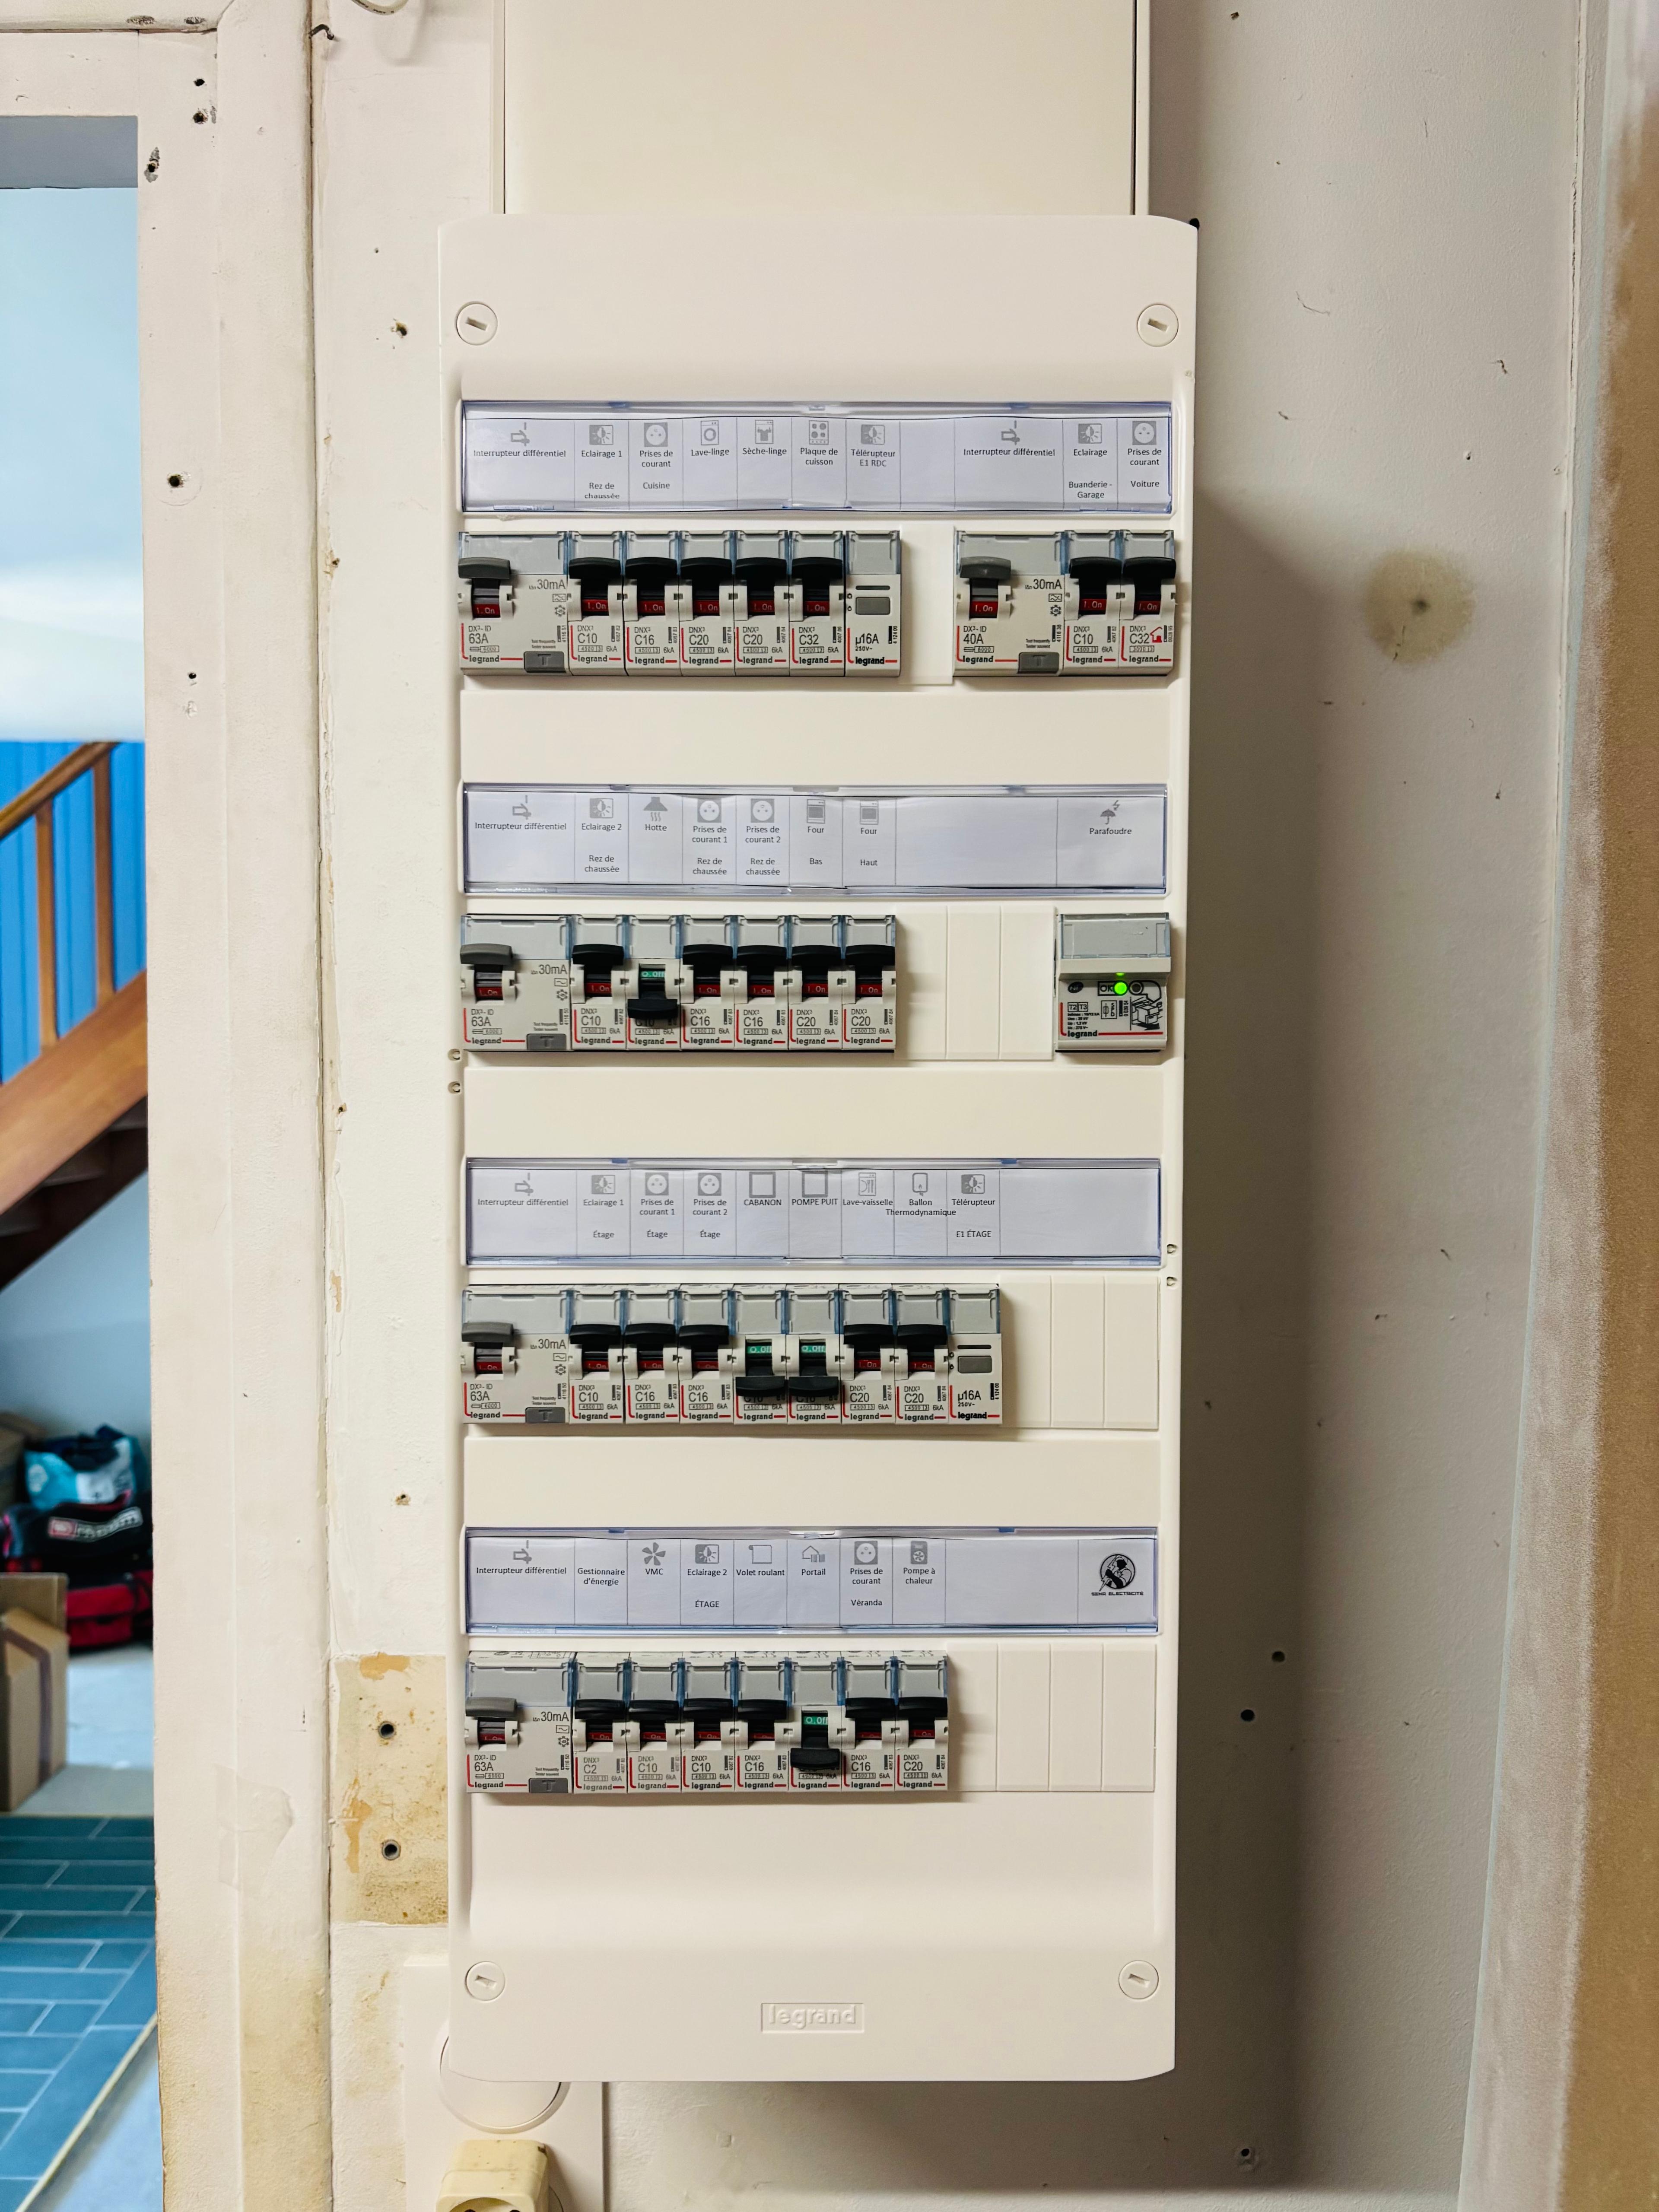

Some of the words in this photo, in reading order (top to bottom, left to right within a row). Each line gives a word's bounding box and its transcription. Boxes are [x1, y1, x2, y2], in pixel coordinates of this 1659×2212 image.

[581, 450, 616, 459] Eclairage
[691, 448, 730, 457] Lave-linge
[743, 447, 787, 456] Sèche-linge
[800, 447, 826, 456] Plaque
[850, 449, 896, 458] Télérupteur
[1013, 448, 1055, 456] différentiel
[1074, 449, 1108, 457] Eclairage
[469, 634, 489, 644] 63A
[577, 633, 597, 644] C10
[635, 634, 655, 645] C16
[689, 634, 709, 645] C20
[743, 634, 763, 645] C20
[799, 634, 819, 645] C32
[963, 633, 984, 645] 40A
[1073, 633, 1093, 645] C10
[1129, 633, 1150, 644] C32
[469, 655, 499, 664] legrand
[578, 655, 607, 664] legrand
[855, 656, 885, 666] legrand
[1073, 655, 1103, 665] legrand
[475, 822, 522, 831] Interrupteur
[582, 823, 616, 832] Eclairage
[471, 1016, 491, 1027] 63A
[581, 1016, 601, 1026] C10
[690, 1016, 710, 1027] C16
[744, 1017, 763, 1027] C16
[796, 1017, 816, 1027] C20
[851, 1016, 871, 1027] C20
[1067, 1030, 1098, 1039] legrand
[744, 1037, 773, 1046] legrand
[796, 1037, 826, 1046] legrand
[477, 1198, 524, 1207] Interrupteur
[583, 1199, 617, 1208] Eclairage
[951, 1198, 996, 1207] Télérupteur
[593, 1230, 615, 1239] Étage
[647, 1229, 668, 1239] Étage
[700, 1229, 721, 1239] Étage
[967, 1229, 992, 1238] ÉTAGE
[470, 1391, 490, 1401] 63A
[578, 1392, 598, 1402] C10
[635, 1391, 655, 1402] C16
[688, 1392, 709, 1402] C16
[849, 1392, 870, 1403] C20
[904, 1393, 924, 1403] C20
[470, 1411, 501, 1420] legrand
[636, 1412, 665, 1421] legrand
[958, 1411, 987, 1421] legrand
[477, 1567, 523, 1575] Interrupteur
[687, 1569, 721, 1577] Eclairage
[903, 1567, 929, 1576] Pompe
[583, 1578, 619, 1586] d'énergie
[695, 1599, 719, 1608] ÉTAGE
[474, 1761, 494, 1772] 63A
[584, 1764, 597, 1774] C2
[638, 1763, 658, 1773] C10
[692, 1762, 711, 1772] C10
[745, 1762, 764, 1772] C16
[851, 1761, 871, 1772] C16
[903, 1761, 923, 1771] C20
[474, 1781, 504, 1789] legrand
[903, 1780, 932, 1789] legrand
[769, 2004, 856, 2029] legrand
